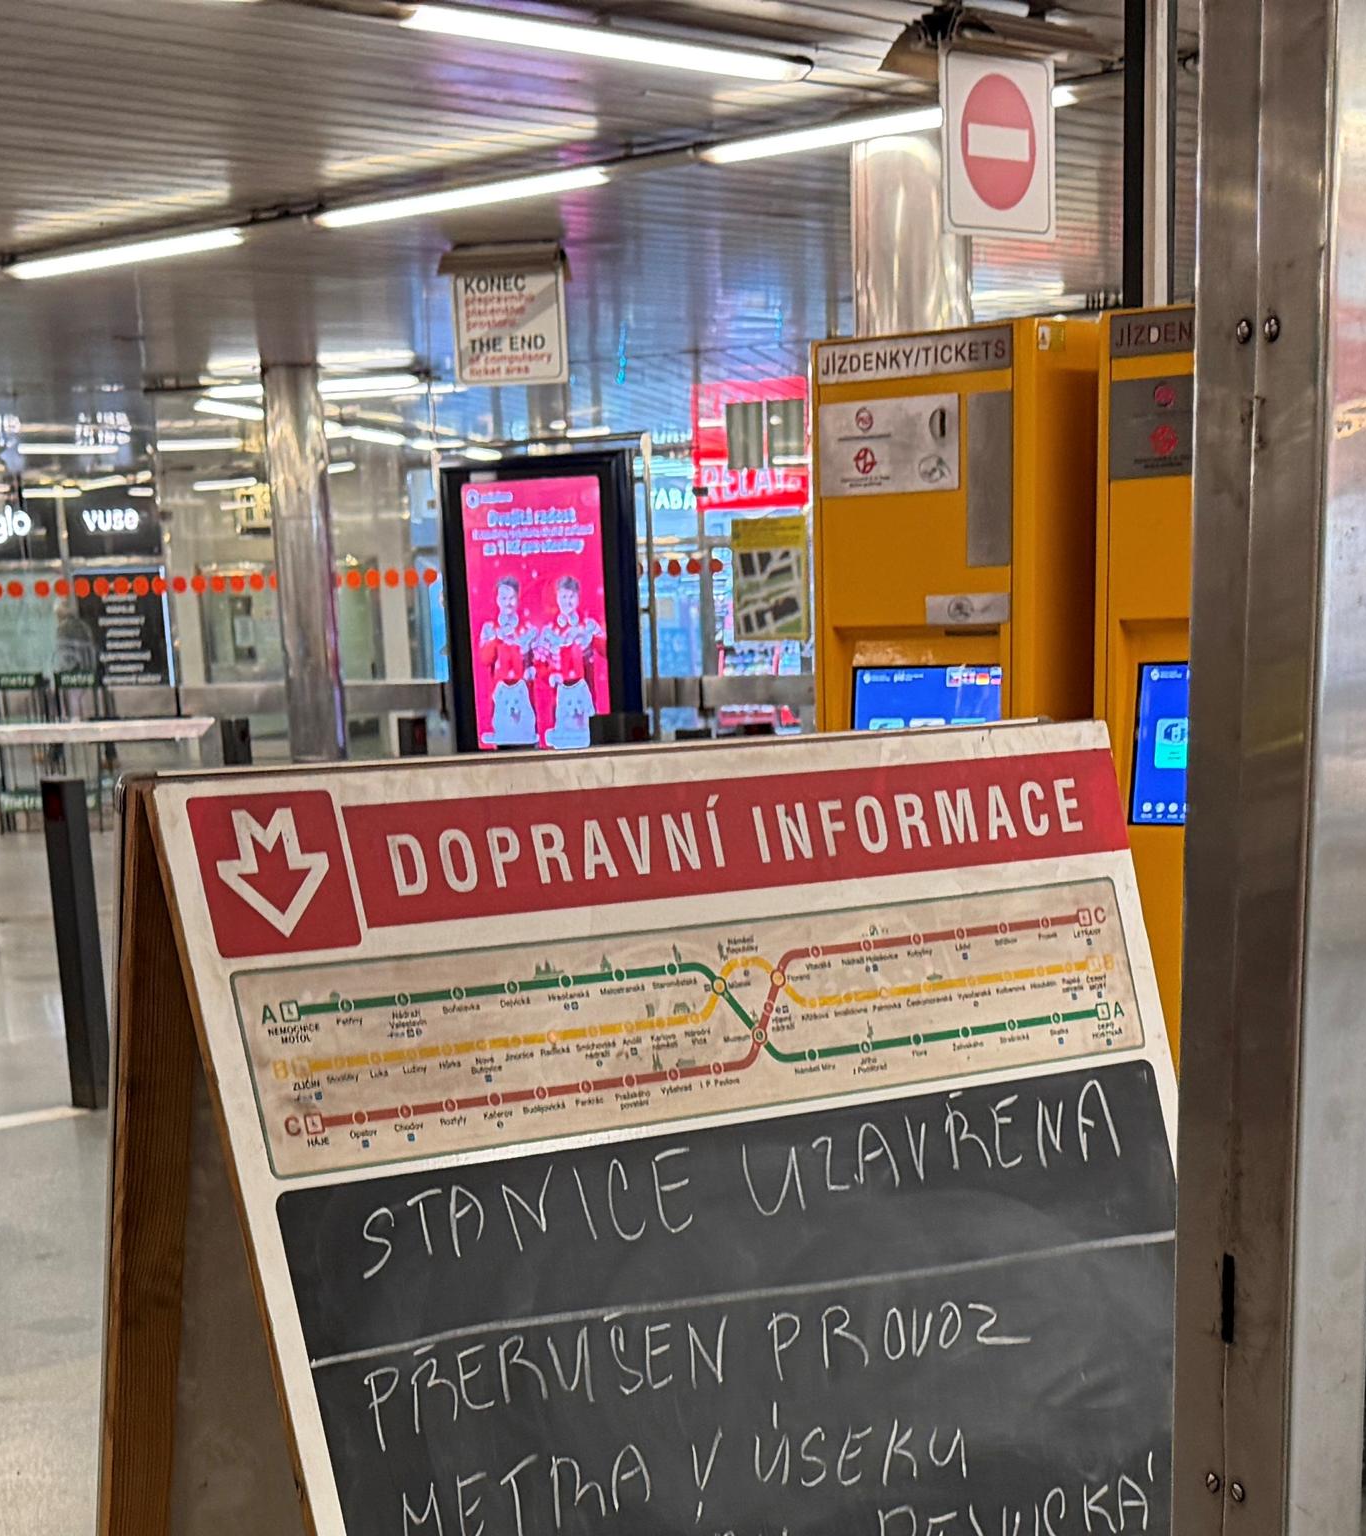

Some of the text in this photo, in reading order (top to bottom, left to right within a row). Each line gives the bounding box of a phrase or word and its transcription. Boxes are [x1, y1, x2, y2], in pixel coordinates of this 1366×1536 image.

[464, 274, 526, 294] KONEC
[470, 335, 546, 353] THE END
[820, 337, 1007, 377] JÍZDENKY/TICKETS
[386, 776, 1085, 900] DOPRAVNÍ INFORMACE
[1094, 907, 1106, 924] C
[262, 1004, 277, 1025] A
[1114, 1001, 1125, 1019] A
[284, 1116, 302, 1137] C
[362, 1079, 1123, 1280] STANICE UZAVŘENA
[363, 1301, 1031, 1452] PŘERUŠEN PROVOZ
[691, 1426, 722, 1491] V
[753, 1401, 968, 1490] ÚSEKU
